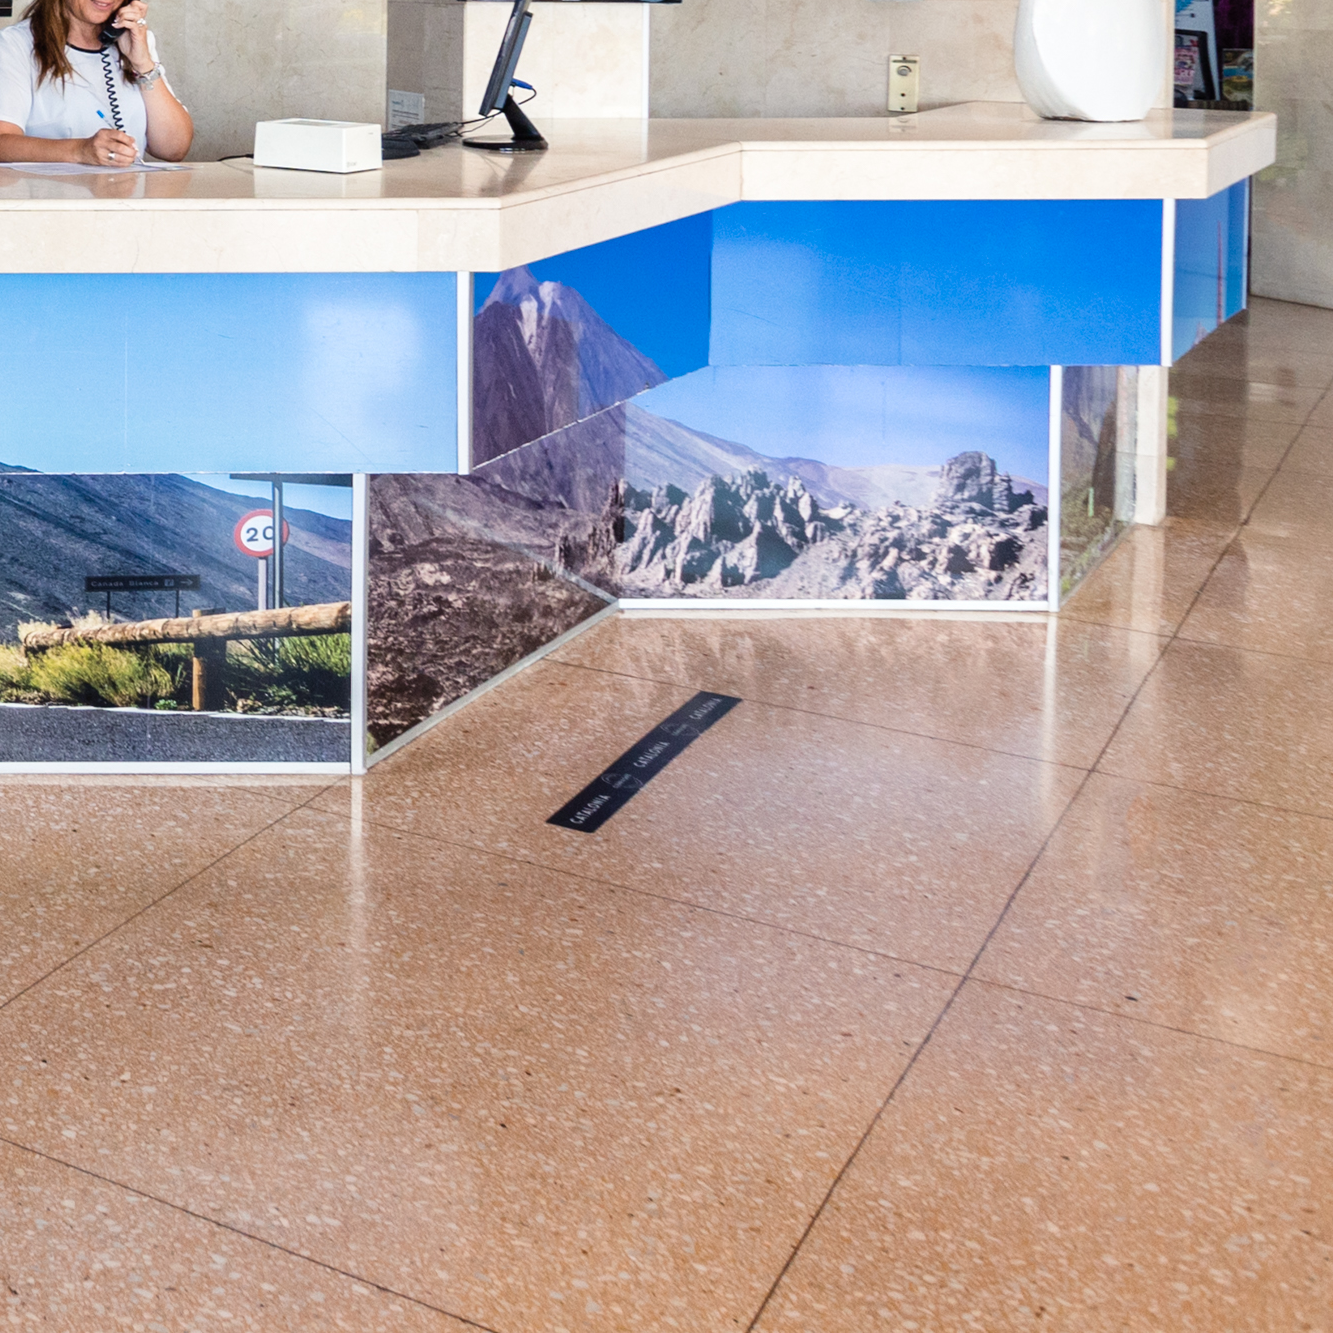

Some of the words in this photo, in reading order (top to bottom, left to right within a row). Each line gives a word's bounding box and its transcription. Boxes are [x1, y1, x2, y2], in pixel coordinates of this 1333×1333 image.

[689, 697, 722, 719] CATALONIA
[633, 741, 670, 767] CATALONIA
[569, 794, 611, 824] CATALONIA
